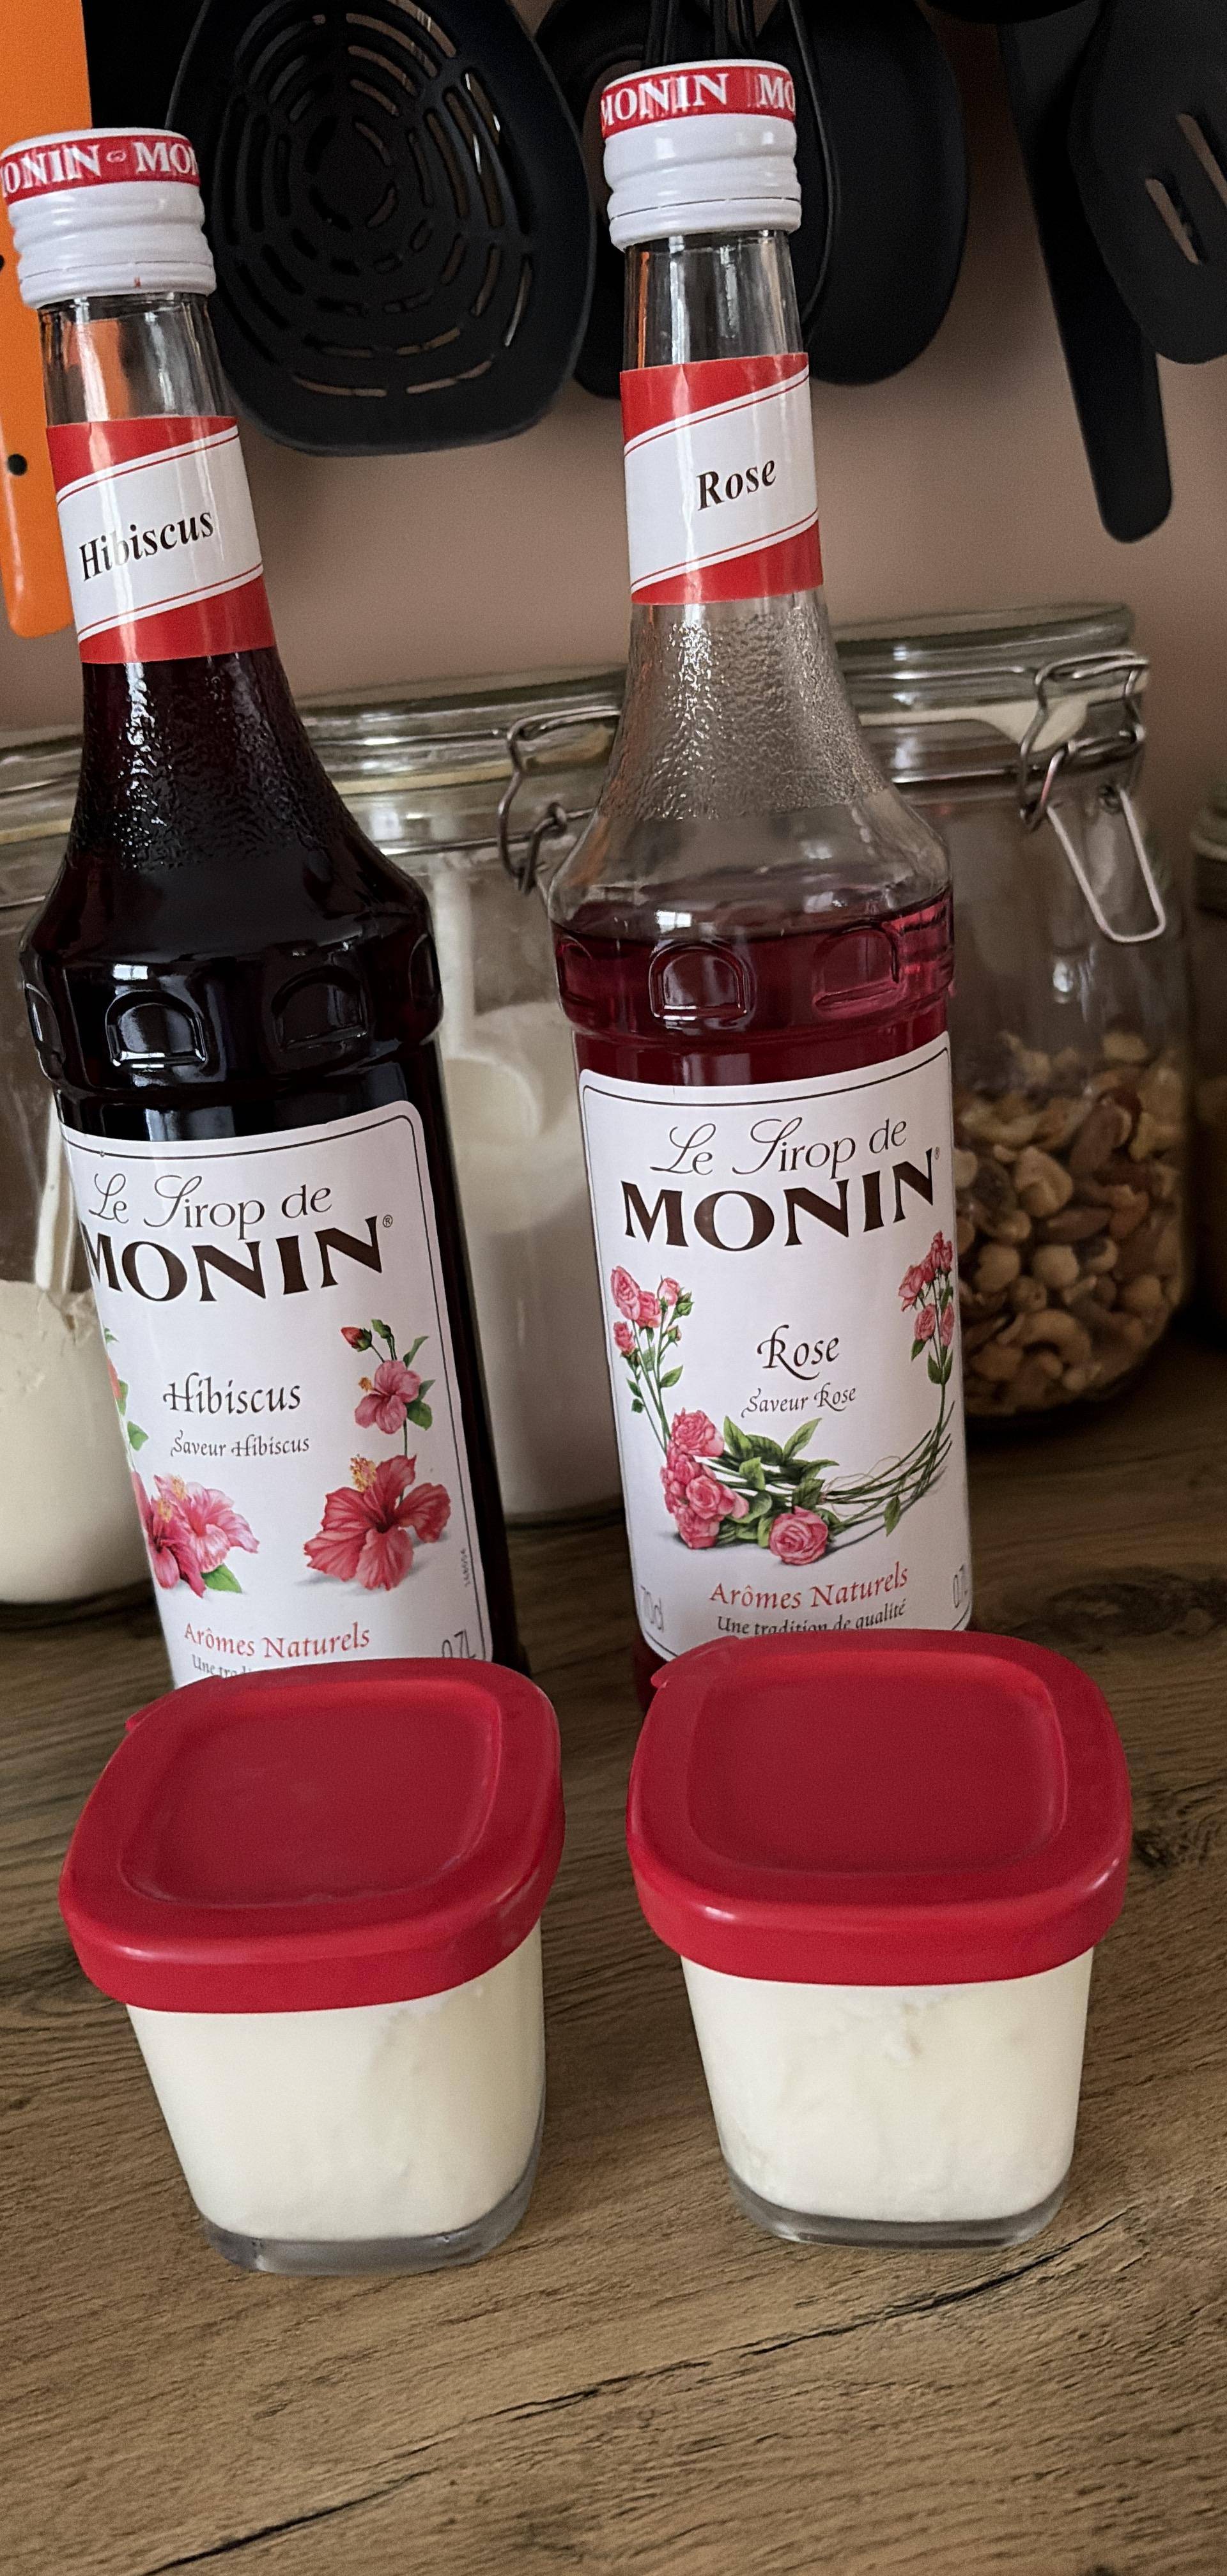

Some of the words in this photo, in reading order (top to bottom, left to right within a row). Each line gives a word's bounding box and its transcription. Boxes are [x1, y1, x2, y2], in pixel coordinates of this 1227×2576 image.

[0, 144, 101, 198] ONIN
[697, 460, 776, 512] Rose
[79, 512, 213, 581] Hibiscus
[649, 1123, 716, 1176] Le
[732, 1117, 856, 1179] Sirop
[869, 1118, 907, 1154] de
[88, 1173, 129, 1224] Le
[143, 1174, 265, 1240] Sirop
[281, 1184, 332, 1219] de
[757, 1324, 840, 1381] Rose
[163, 1372, 300, 1414] Hibiscus
[741, 1388, 808, 1418] Saveur
[814, 1382, 856, 1412] Rose
[170, 1429, 226, 1457] Saveur
[231, 1434, 309, 1457] Hibiscus
[709, 1583, 802, 1609] Arômes
[810, 1561, 908, 1607] Naturels
[184, 1623, 256, 1657] Arômes
[261, 1621, 370, 1658] Naturels
[717, 1616, 750, 1634] Une
[833, 1614, 852, 1630] de
